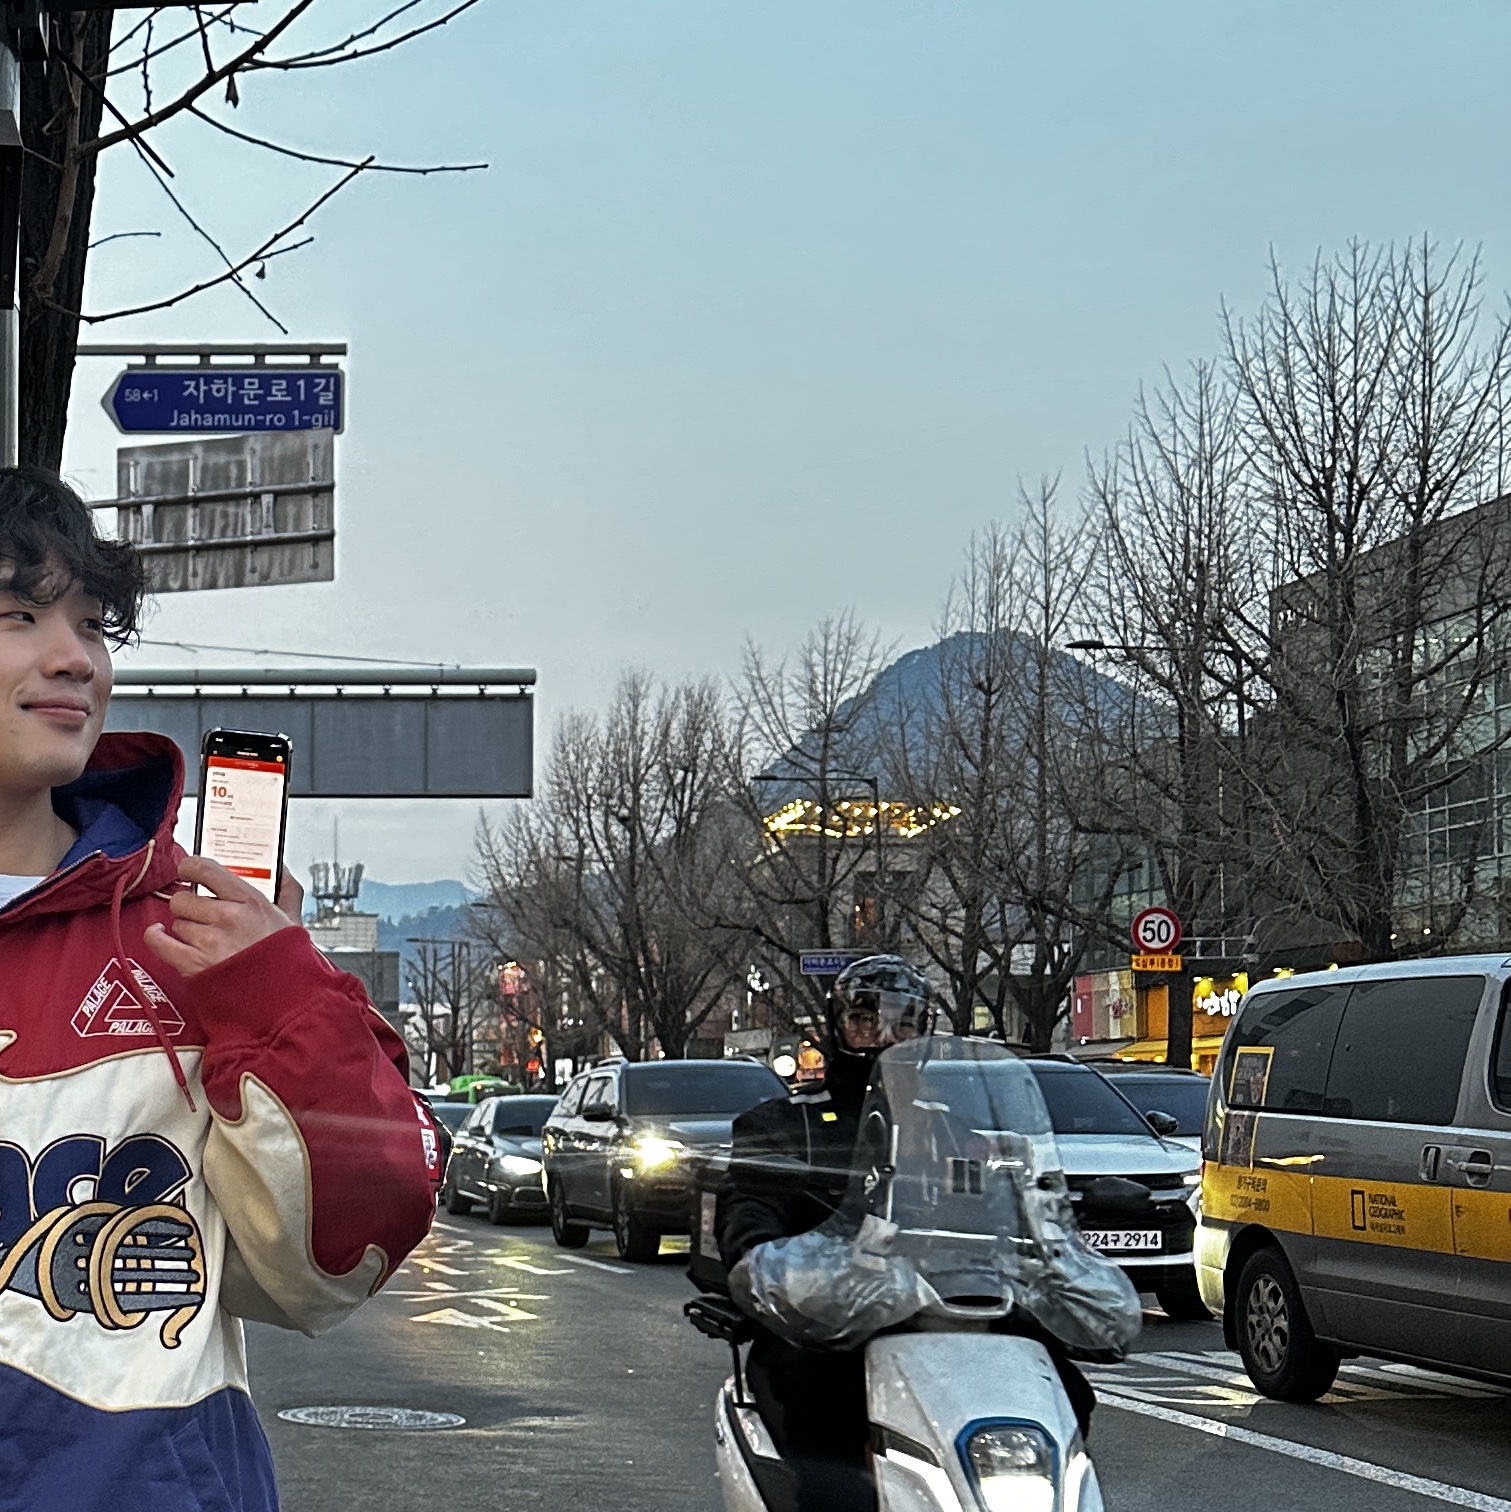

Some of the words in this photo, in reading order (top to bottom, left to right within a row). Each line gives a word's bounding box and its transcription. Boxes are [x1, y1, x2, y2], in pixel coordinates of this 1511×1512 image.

[182, 376, 336, 406] 자하문로1길
[169, 410, 286, 427] Jahamun-ro
[292, 409, 335, 430] 1-gil
[211, 785, 227, 798] 10
[1142, 920, 1171, 943] 50
[81, 976, 112, 1018] PALACE
[108, 1021, 156, 1034] PALAC
[1368, 1193, 1397, 1207] NATIONAL
[1368, 1206, 1406, 1221] GEOGRAPHIC
[1123, 1232, 1159, 1247] 2914
